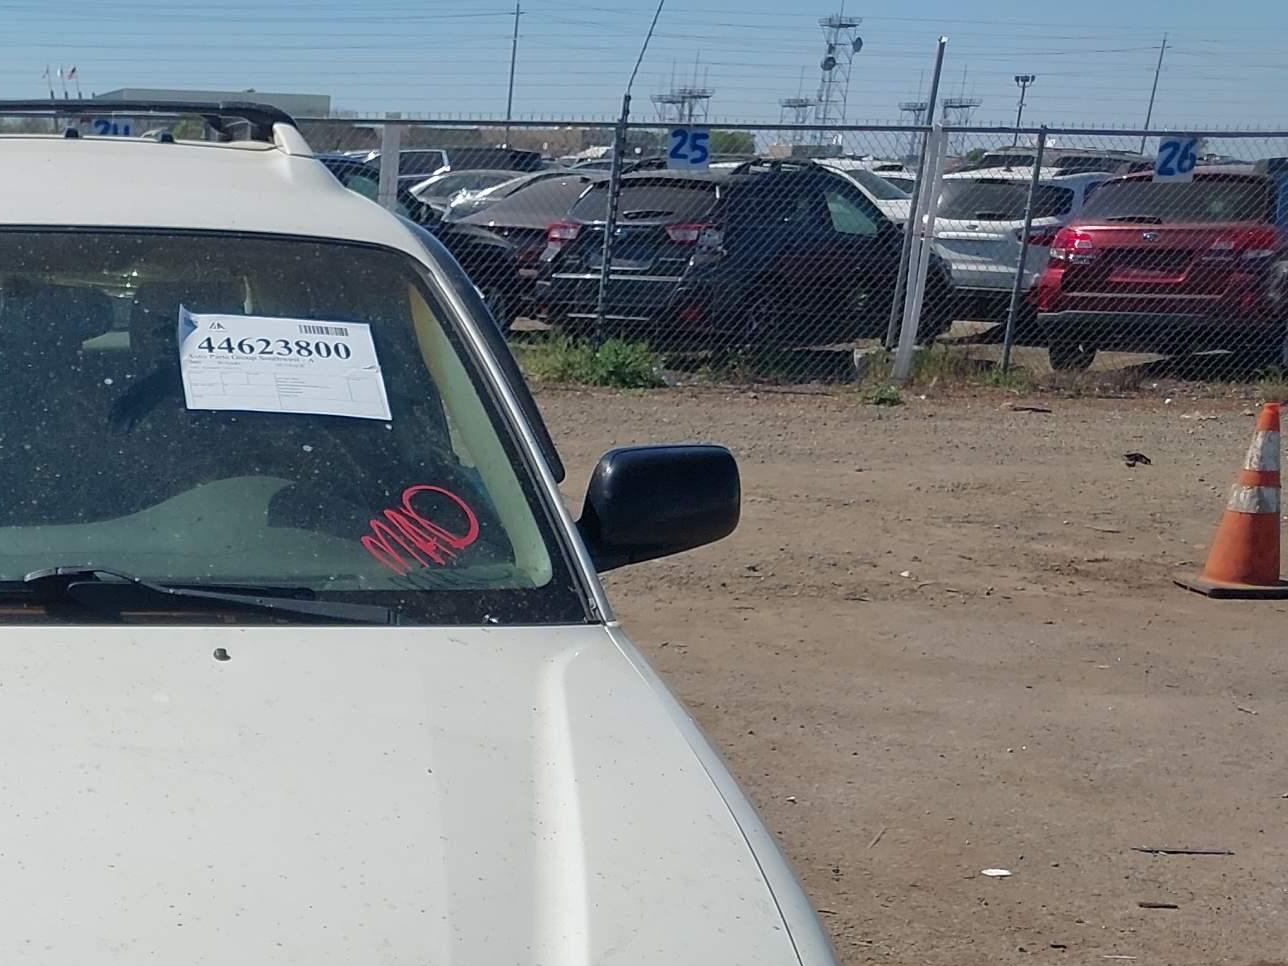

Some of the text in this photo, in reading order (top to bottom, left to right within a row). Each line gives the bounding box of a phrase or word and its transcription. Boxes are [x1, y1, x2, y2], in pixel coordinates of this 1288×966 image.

[670, 129, 709, 164] 25
[1158, 138, 1198, 176] 26
[198, 336, 351, 360] 44623800
